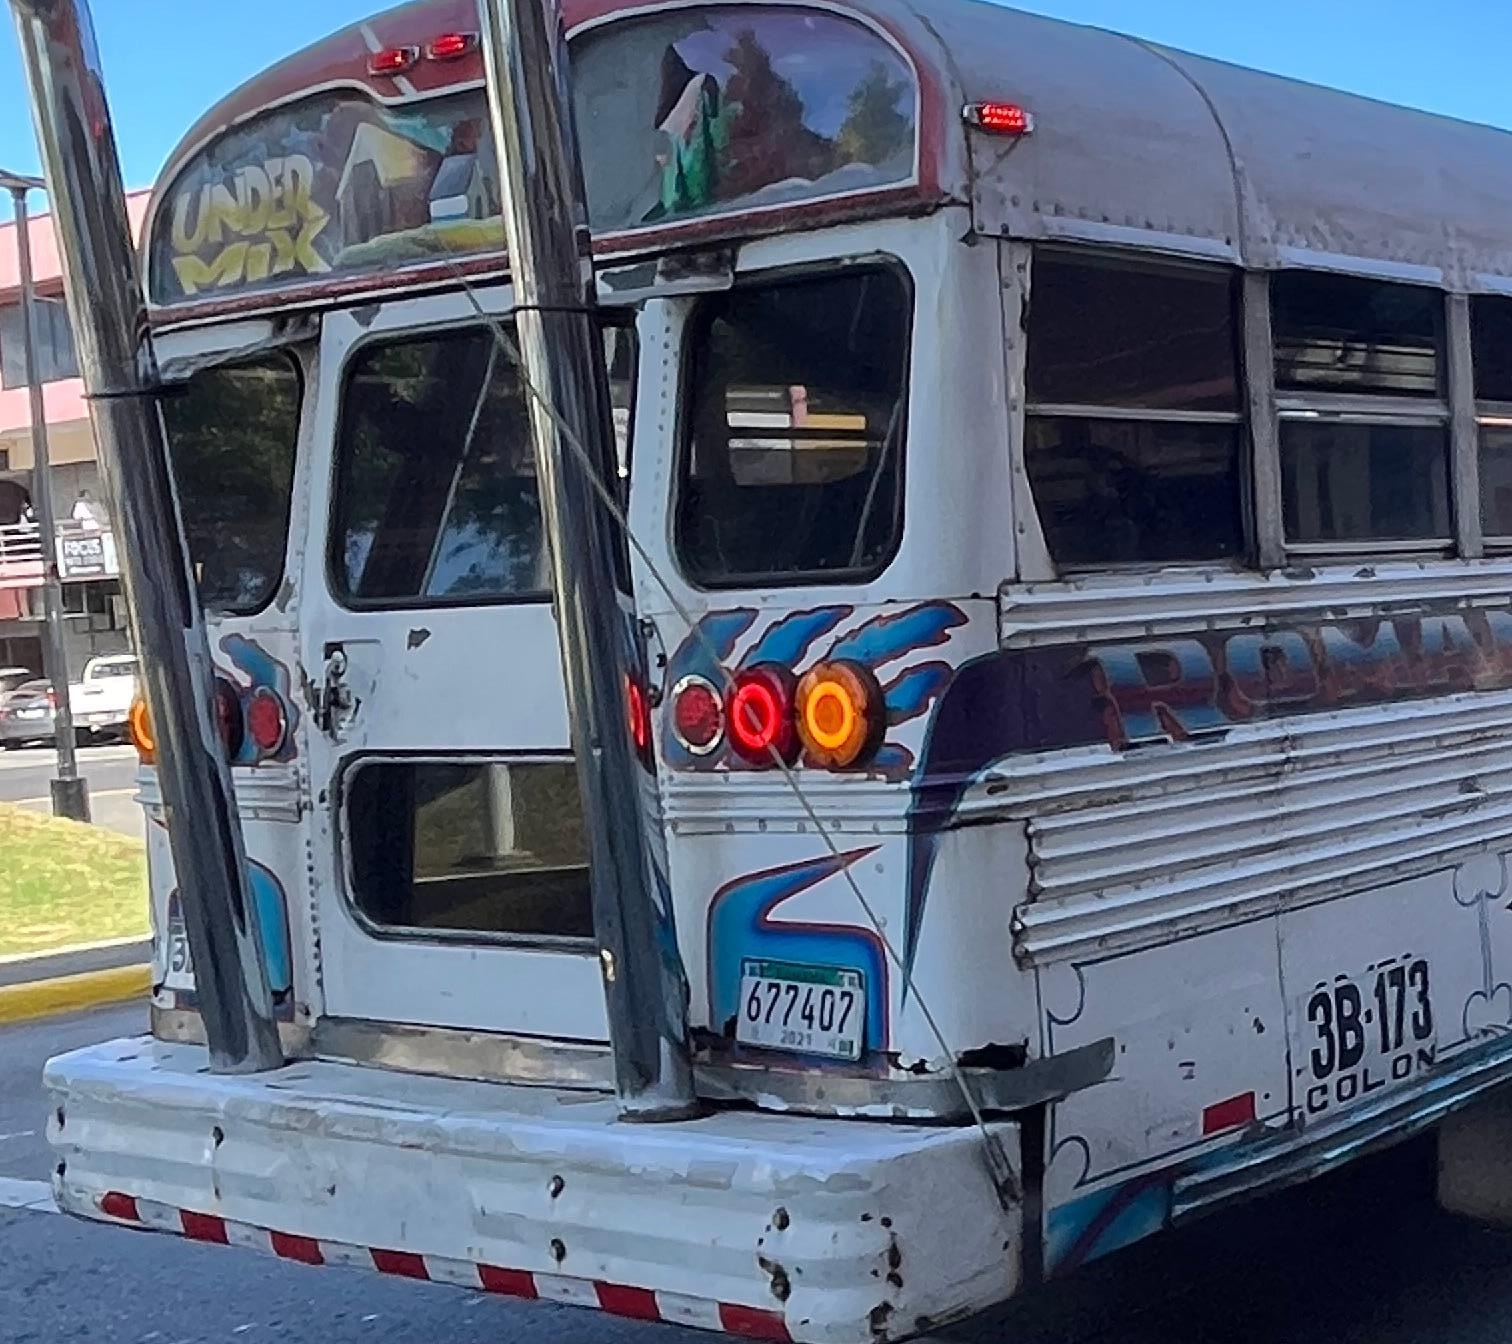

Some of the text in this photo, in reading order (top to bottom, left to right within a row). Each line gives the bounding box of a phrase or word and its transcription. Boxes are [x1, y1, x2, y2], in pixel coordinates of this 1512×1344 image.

[172, 155, 324, 254] UNDER
[172, 213, 332, 295] MIX
[747, 980, 854, 1034] 677407
[1307, 959, 1433, 1080] 3B-173
[1306, 1044, 1436, 1114] COLON
